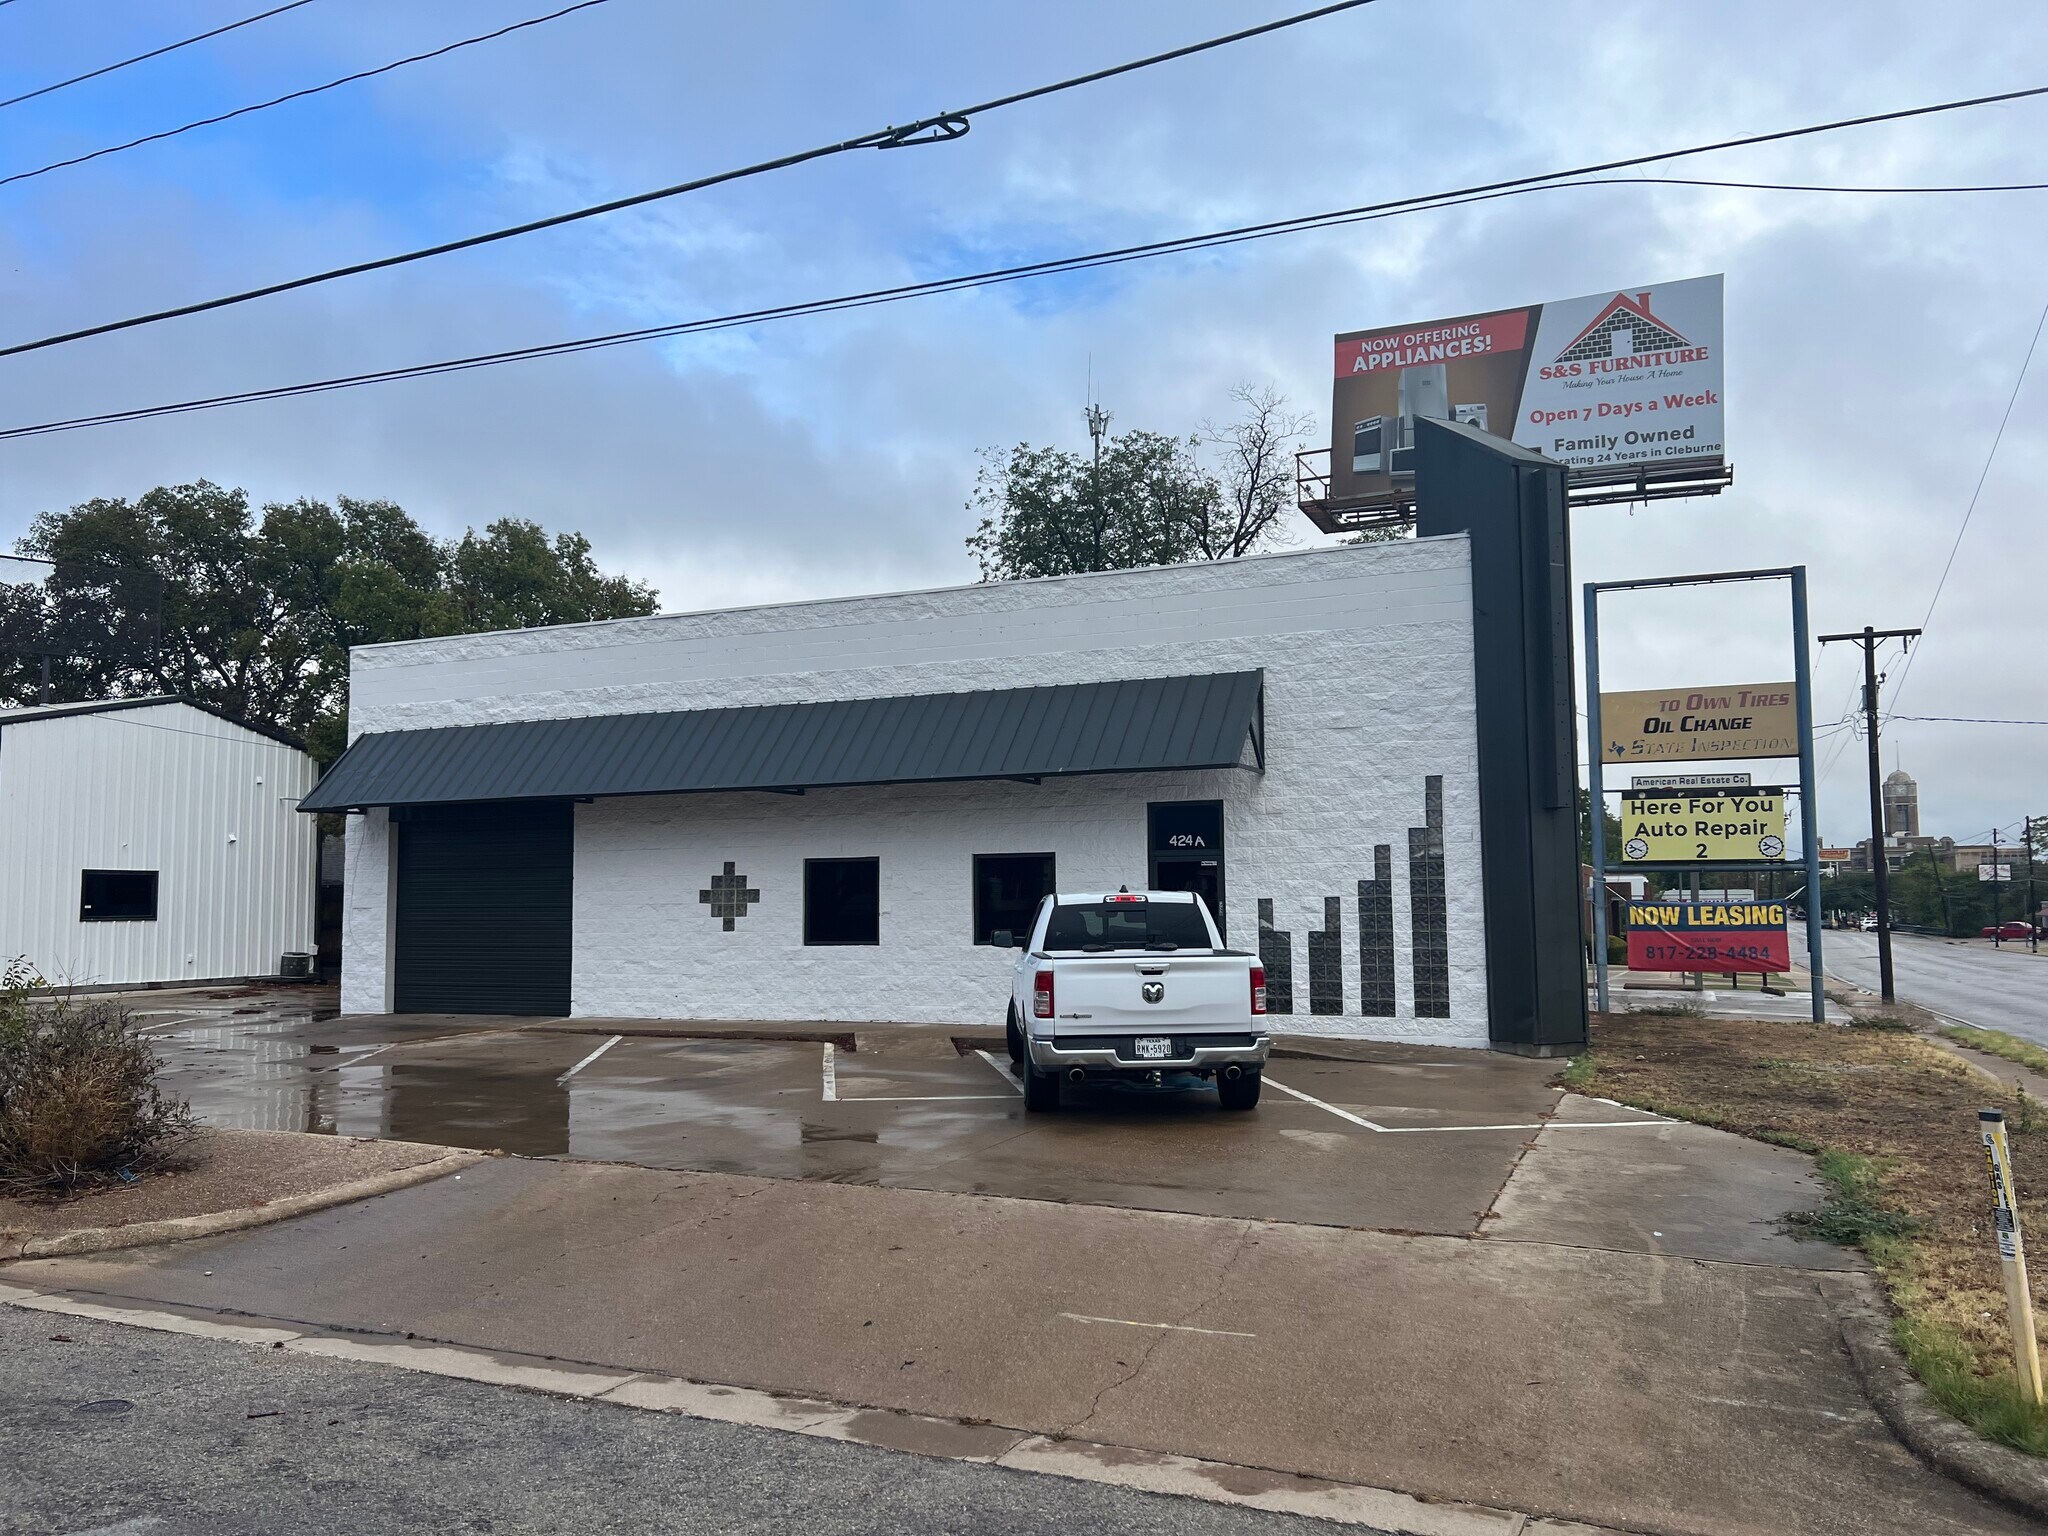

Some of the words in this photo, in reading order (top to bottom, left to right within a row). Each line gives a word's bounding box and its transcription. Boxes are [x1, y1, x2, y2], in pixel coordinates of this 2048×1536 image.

[1361, 337, 1400, 353] NOW
[1403, 323, 1480, 346] OFFERING
[1352, 334, 1492, 372] APPLIANCES!
[1539, 363, 1582, 380] S&S
[1589, 346, 1709, 375] FURNITURE
[1562, 380, 1593, 390] Making
[1596, 377, 1615, 386] Your
[1617, 373, 1644, 383] House
[1646, 370, 1656, 379] A
[1658, 368, 1684, 378] Home
[1530, 409, 1578, 426] Open
[1583, 408, 1592, 421] 7
[1597, 402, 1643, 418] Days
[1648, 400, 1658, 411] a
[1663, 389, 1718, 409] Week
[1554, 434, 1619, 452] Family
[1624, 425, 1695, 445] Owned
[1597, 453, 1611, 463] 24
[1614, 450, 1648, 461] Years
[1650, 448, 1662, 457] in
[1665, 443, 1722, 456] Cleburne
[1738, 691, 1790, 708] TIRES
[1680, 715, 1752, 732] CHANGE
[1636, 777, 1677, 787] American
[1679, 777, 1698, 785] Real
[1701, 776, 1731, 785] Estate
[1733, 775, 1748, 783] Co.
[1631, 800, 1682, 815] Here
[1689, 799, 1725, 814] For
[1730, 798, 1774, 813] You
[1634, 822, 1688, 837] Auto
[1695, 819, 1768, 839] Repair
[1695, 843, 1708, 859] 2
[1629, 906, 1680, 926] NOW
[1687, 905, 1784, 926] LEASING
[1645, 945, 1771, 960] 817-228-4484
